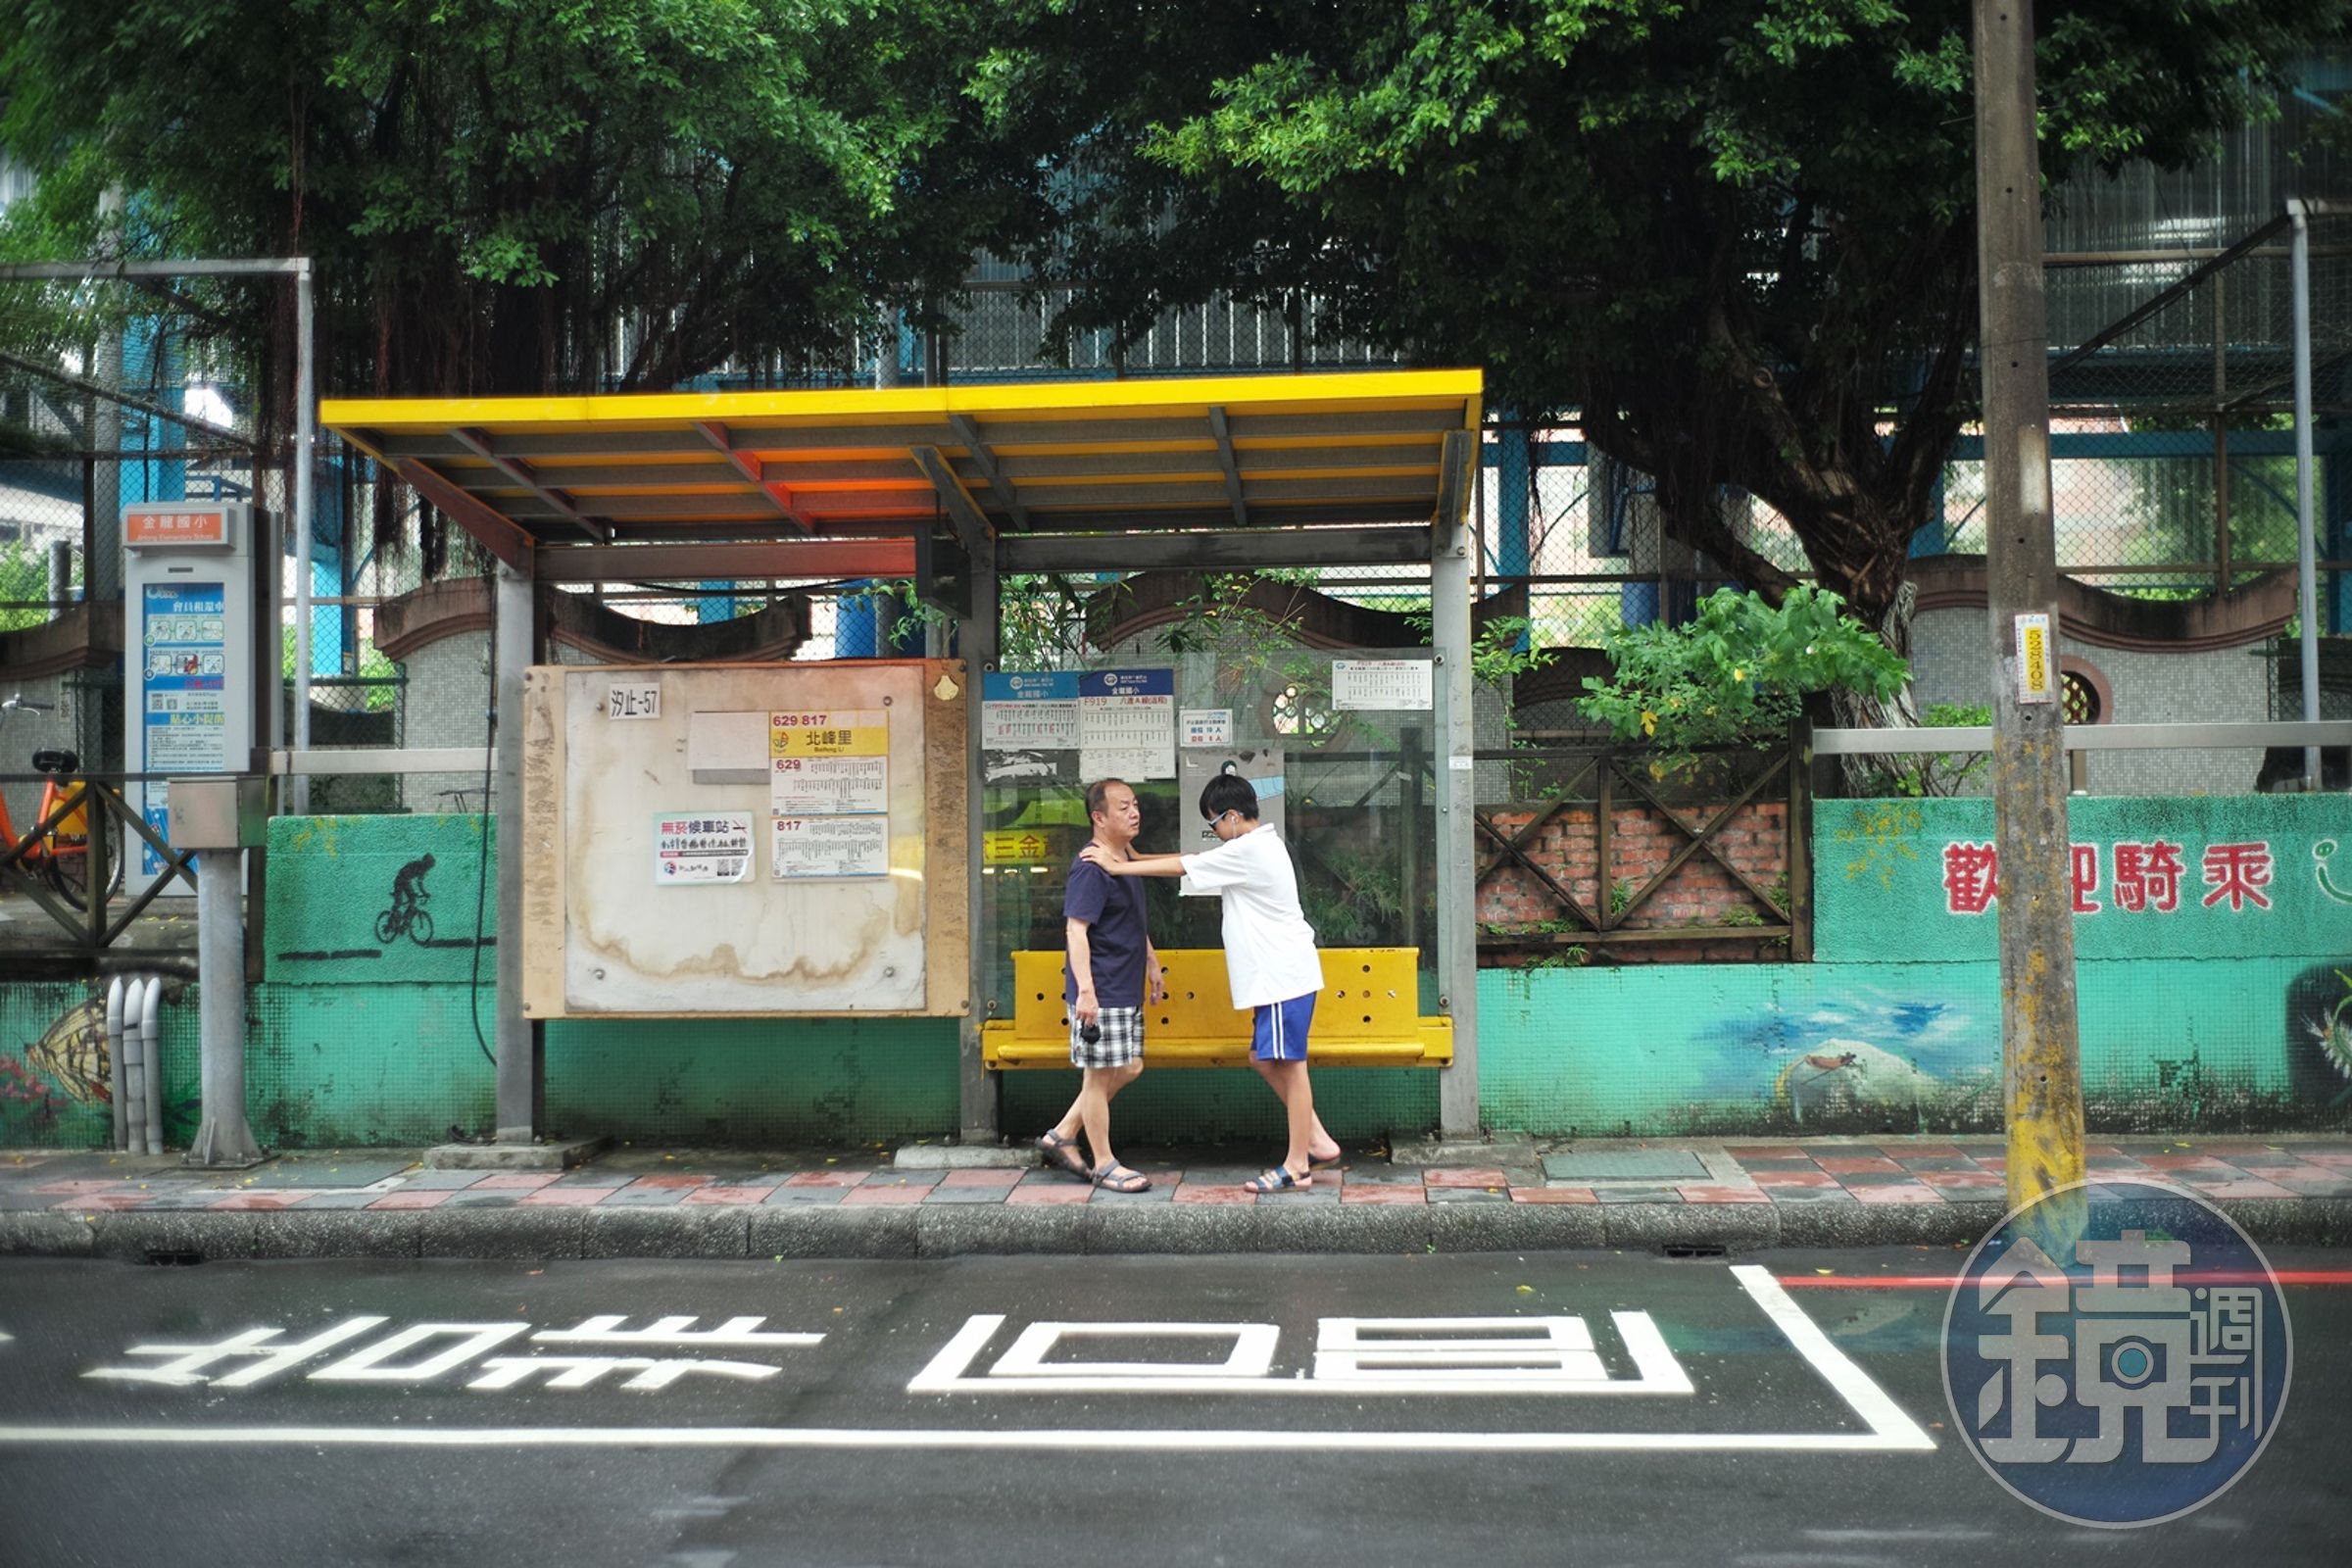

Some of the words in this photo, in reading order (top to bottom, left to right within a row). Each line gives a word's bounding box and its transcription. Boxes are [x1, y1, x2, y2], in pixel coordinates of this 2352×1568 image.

[142, 514, 208, 529] 金龍國小
[611, 689, 658, 717] 汐止-57
[1084, 697, 1107, 706] F919
[773, 715, 798, 726] 629
[802, 714, 827, 725] 817
[806, 730, 852, 745] 北峰里
[776, 760, 802, 770] 629
[776, 821, 802, 831] 817
